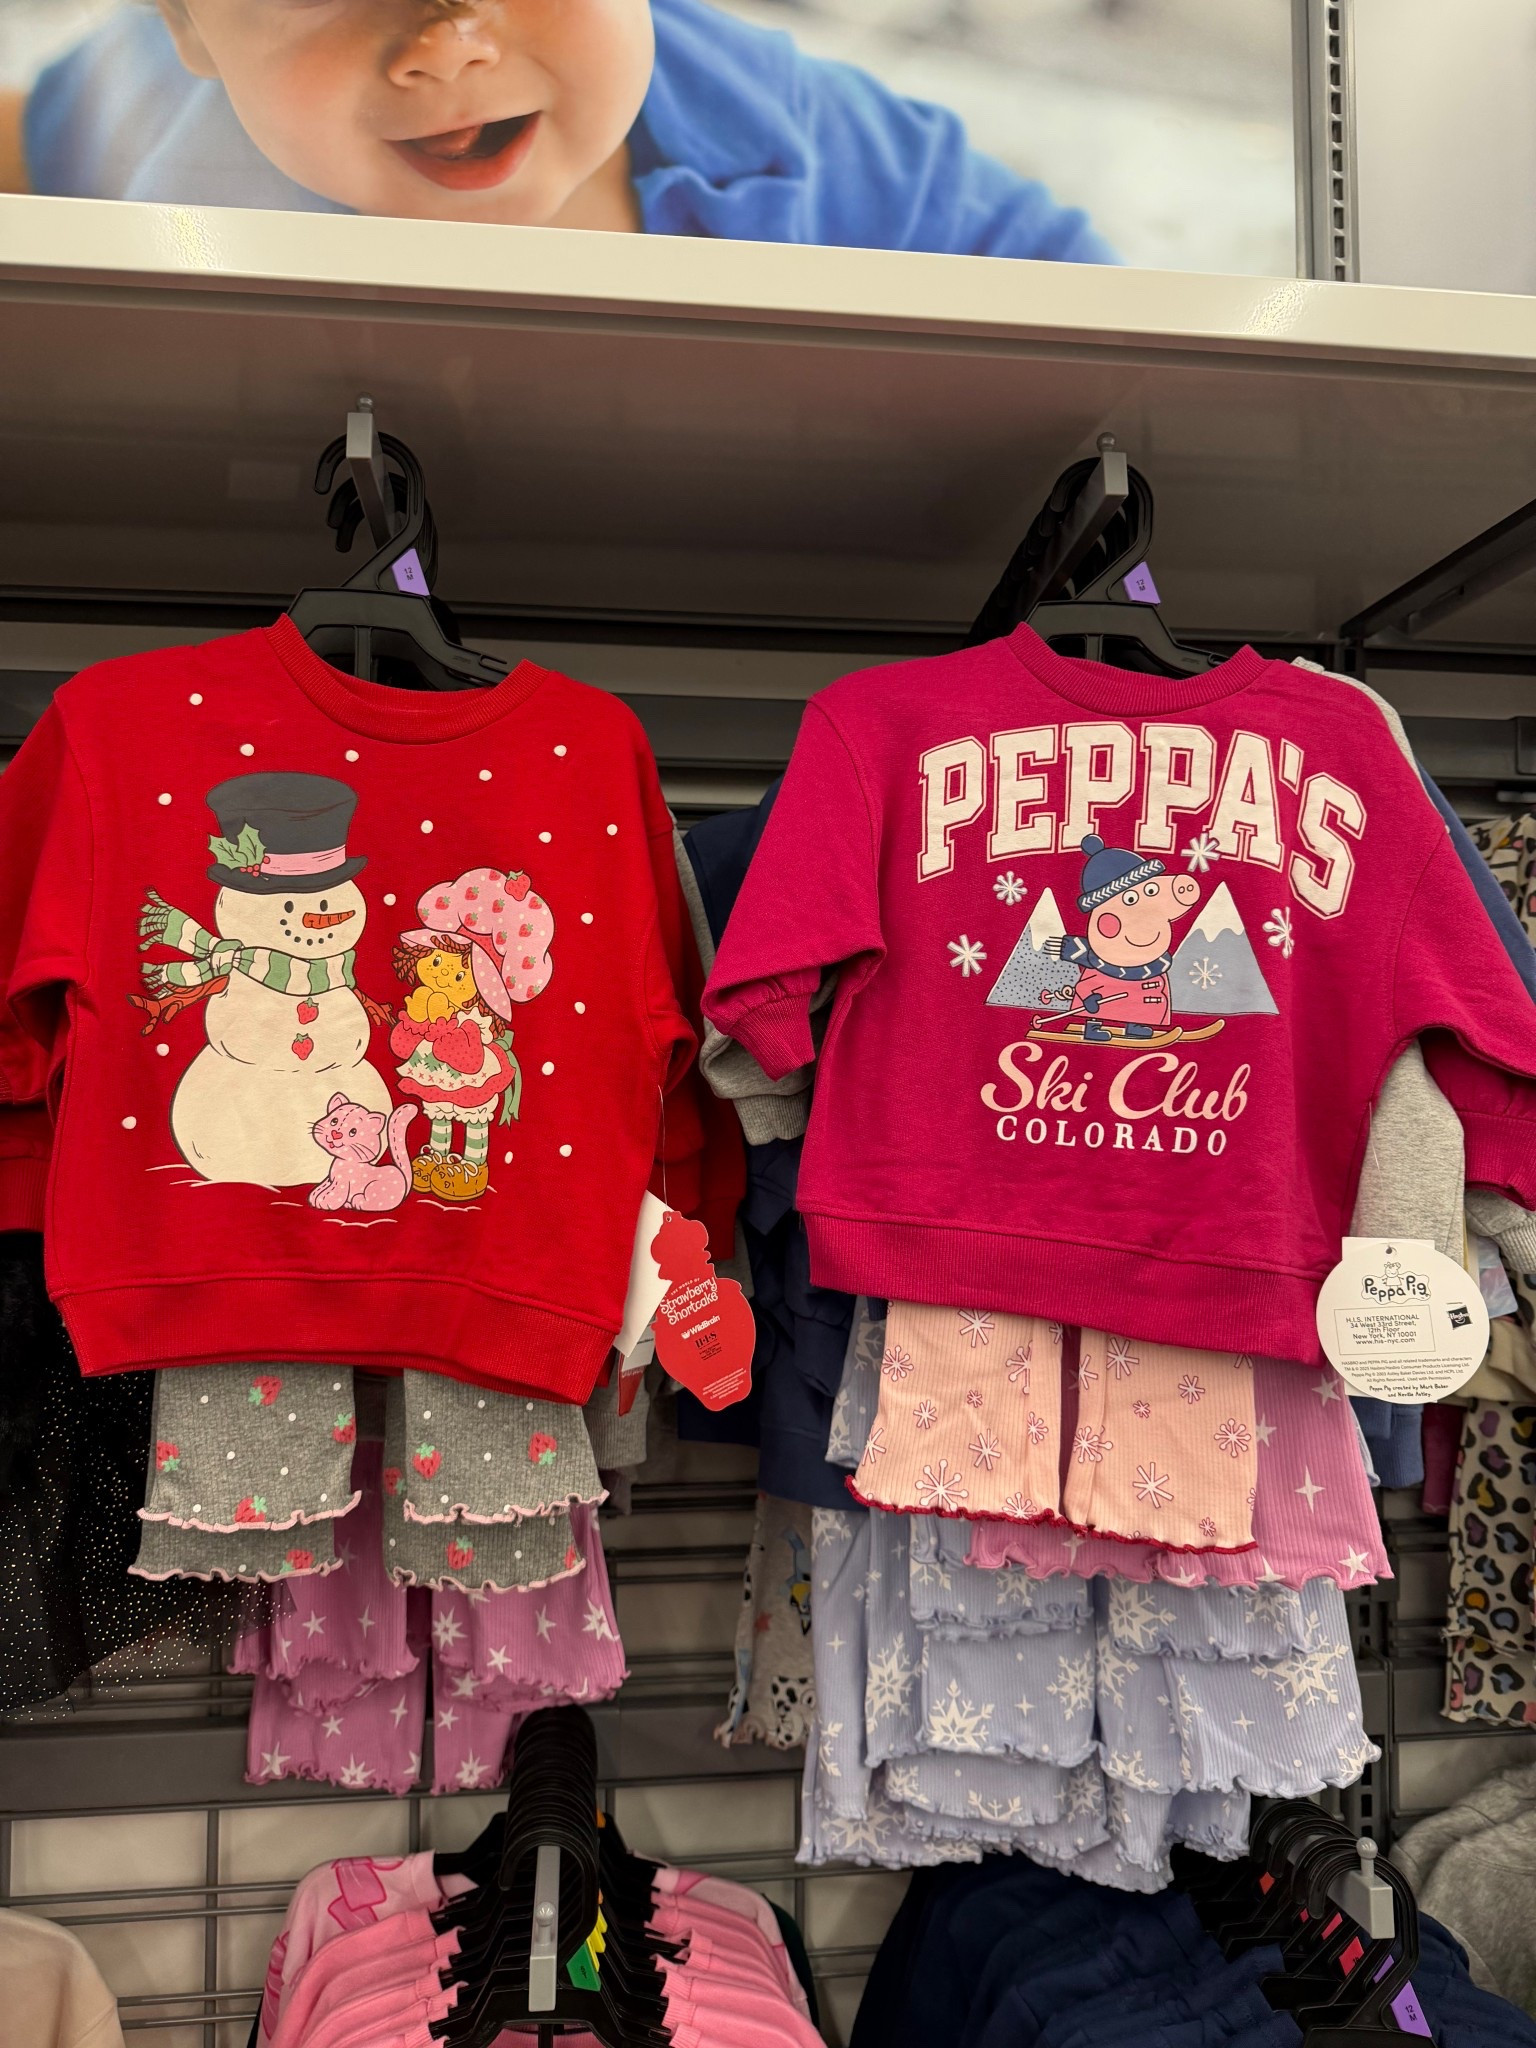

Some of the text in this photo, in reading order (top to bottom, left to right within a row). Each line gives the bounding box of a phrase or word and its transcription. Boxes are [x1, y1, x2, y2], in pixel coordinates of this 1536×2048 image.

[917, 720, 1368, 920] PEPPA'S
[980, 1040, 1252, 1122] Ski Club
[996, 1114, 1227, 1157] COLORADO
[660, 1276, 718, 1315] Strawberry
[1364, 1275, 1427, 1303] Peppa Pig
[667, 1291, 719, 1326] Shortcake
[1364, 1314, 1420, 1323] INTERNATIONAL
[689, 1315, 721, 1335] WildBrain
[1405, 2004, 1414, 2013] 12
[1409, 2013, 1418, 2021] M
